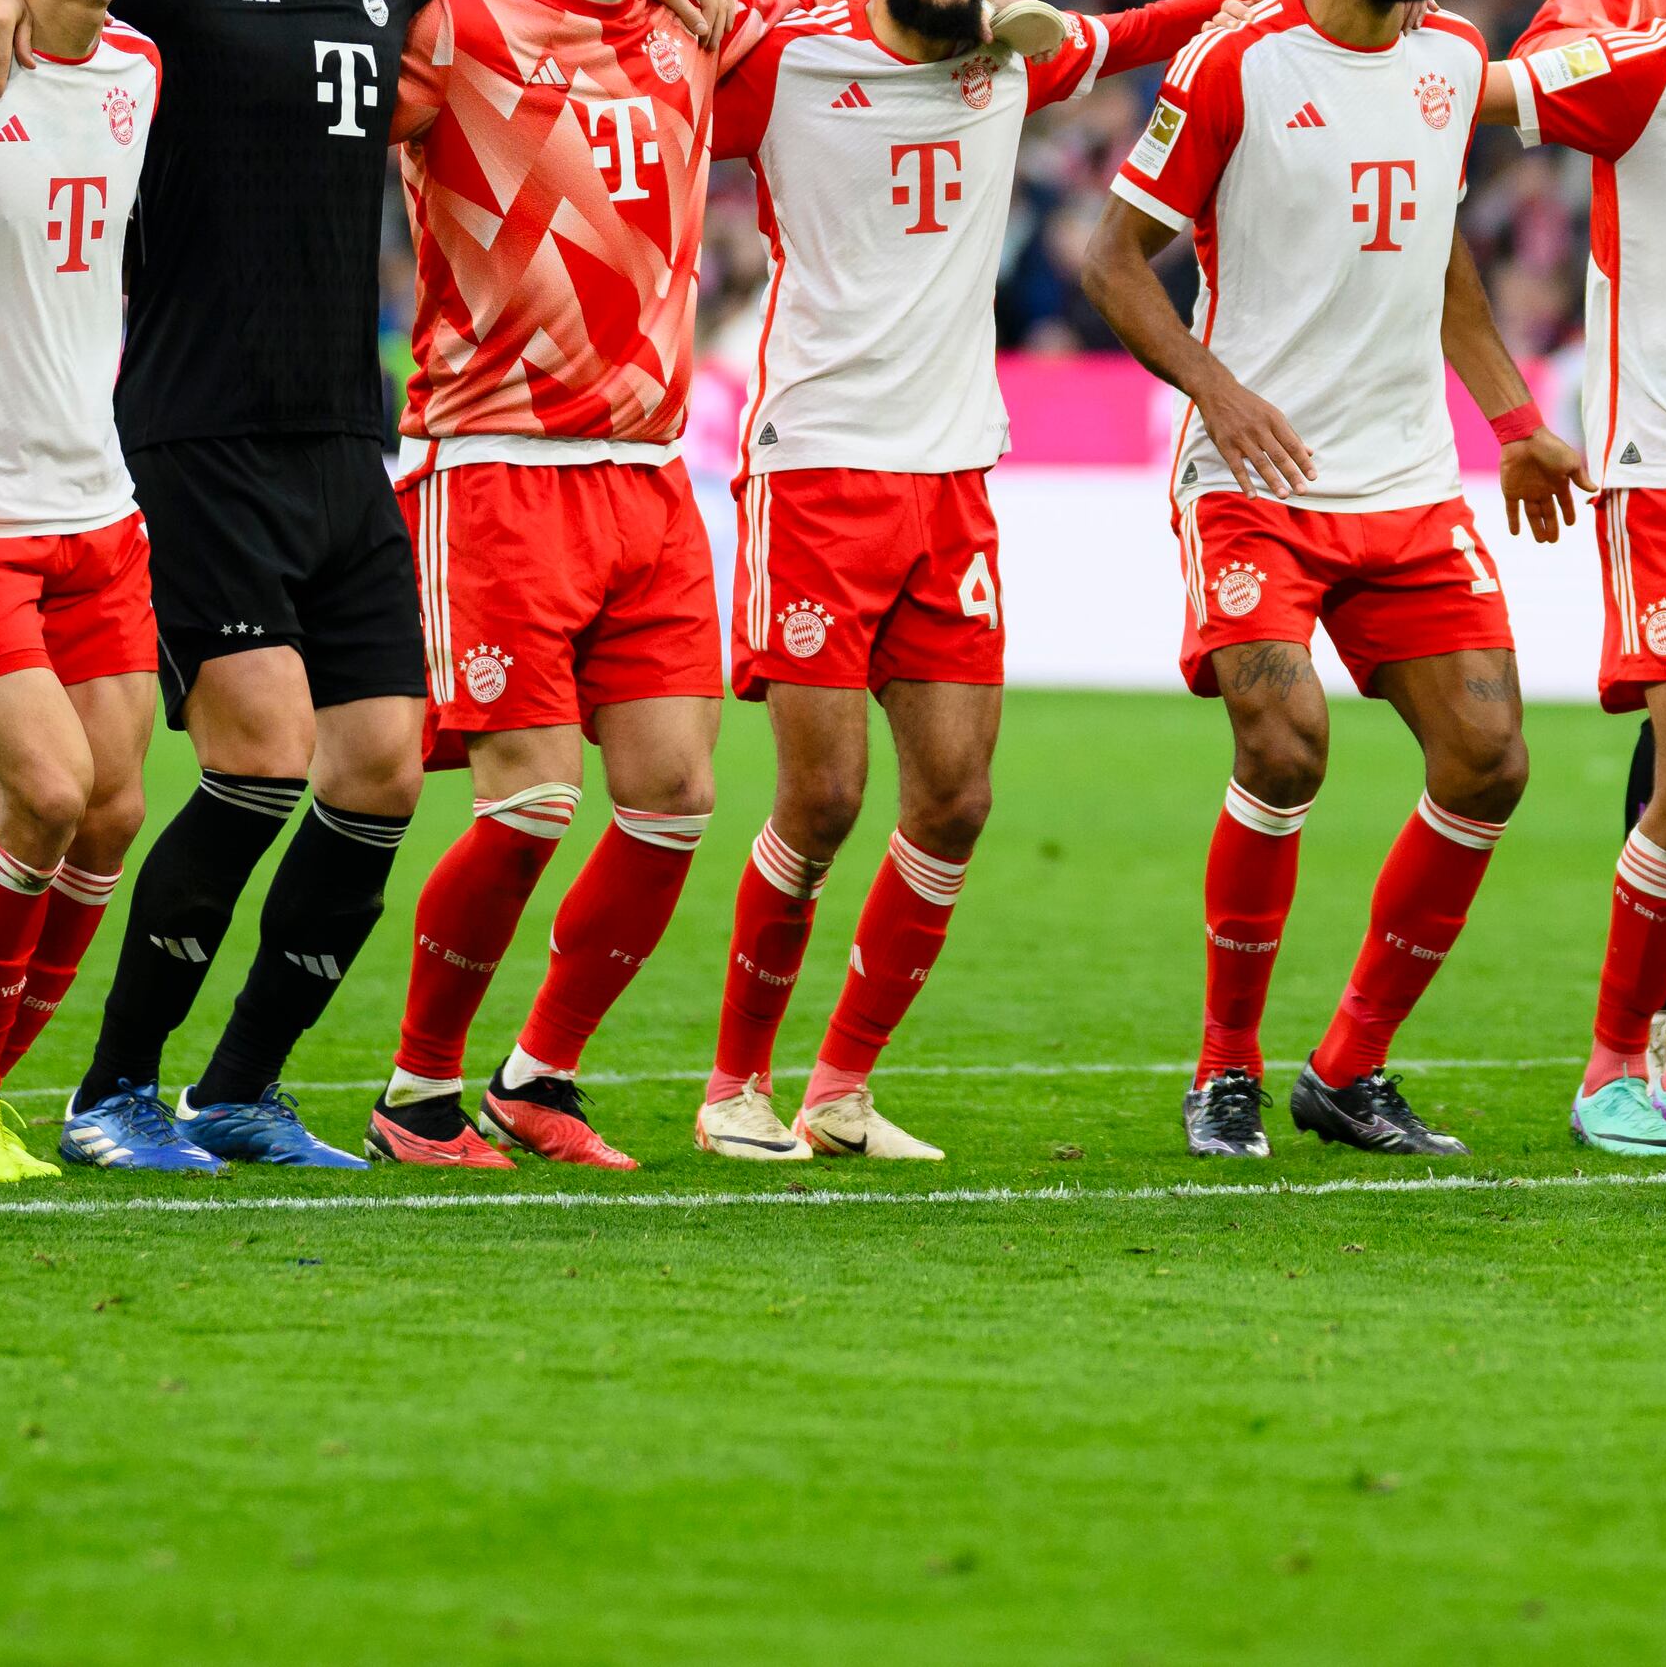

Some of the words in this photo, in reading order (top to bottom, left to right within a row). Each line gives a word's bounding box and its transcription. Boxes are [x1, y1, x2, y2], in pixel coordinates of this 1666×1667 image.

[419, 934, 440, 954] FC
[1214, 934, 1278, 953] BAYERN
[1386, 932, 1406, 950] FC
[737, 952, 753, 974] FC
